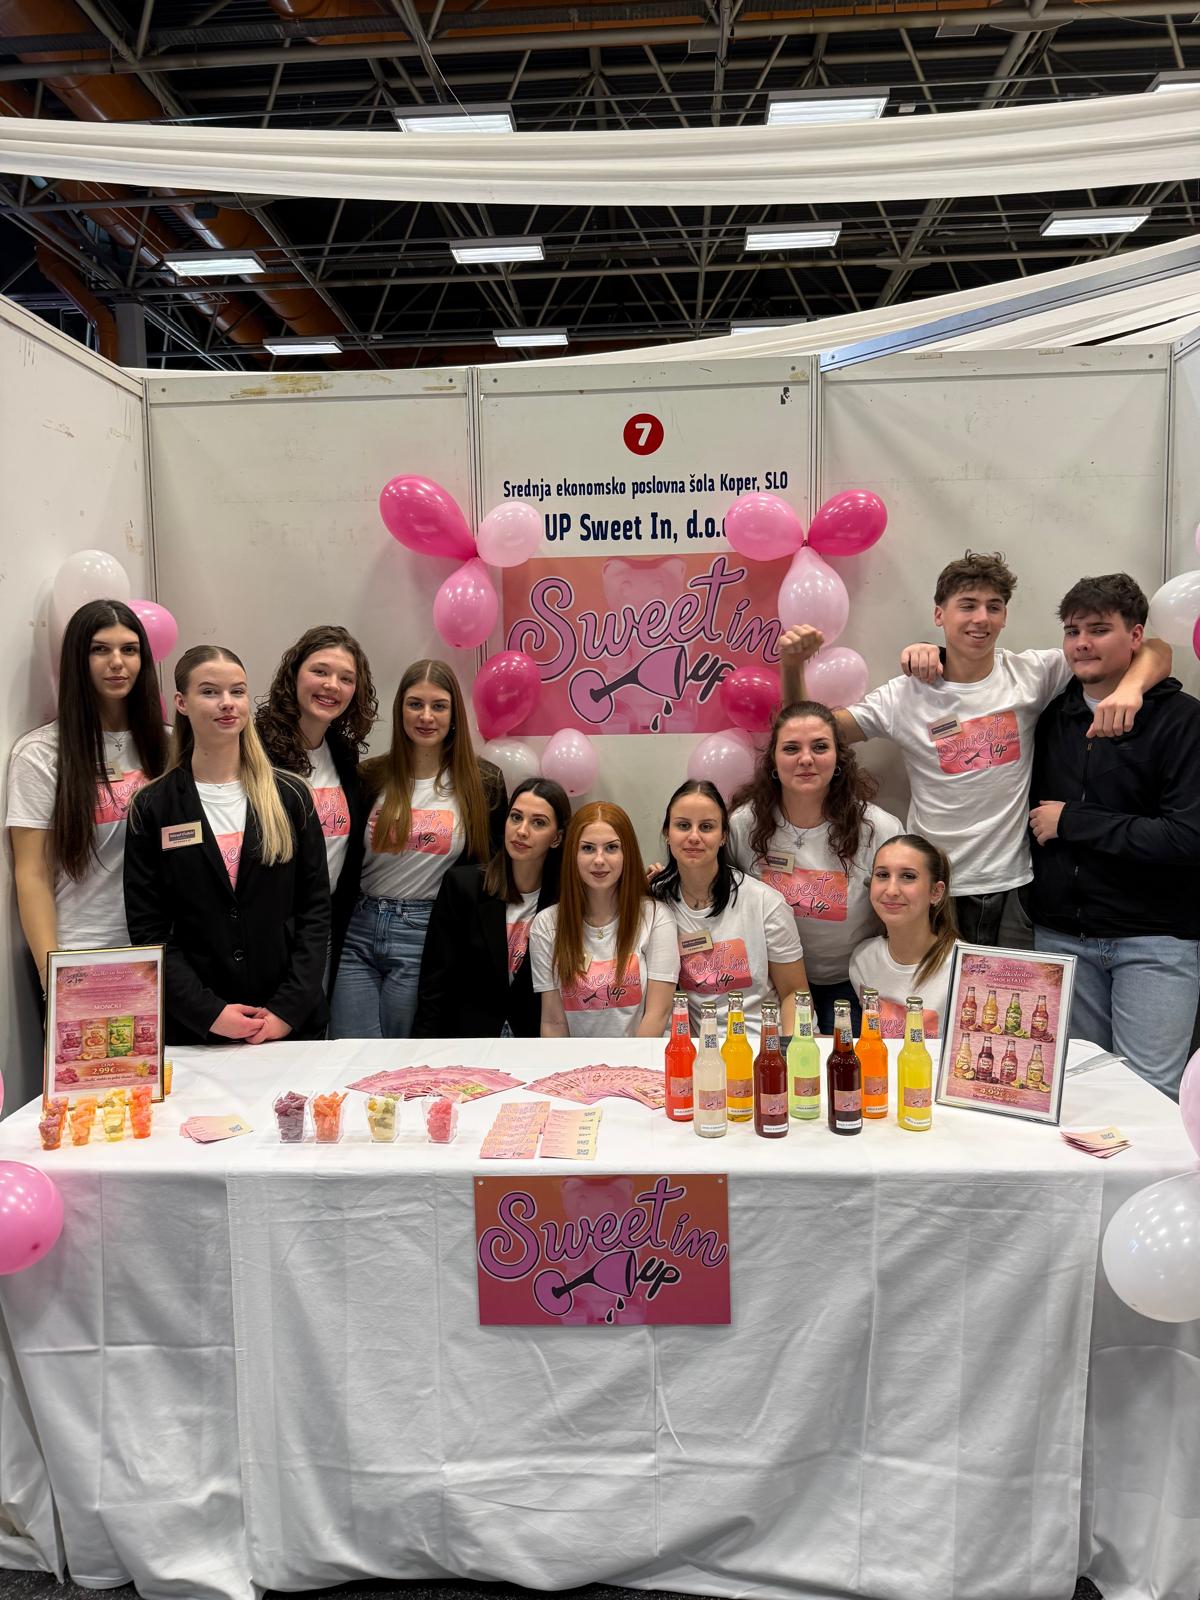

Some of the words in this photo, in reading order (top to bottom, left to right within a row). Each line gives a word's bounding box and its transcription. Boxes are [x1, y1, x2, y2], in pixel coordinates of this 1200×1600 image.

[634, 422, 652, 447] 7
[503, 479, 551, 501] Srednja
[556, 476, 626, 496] ekonomsko
[631, 475, 685, 499] poslovna
[689, 473, 715, 493] šola
[720, 473, 760, 495] Koper,
[765, 471, 788, 489] SLO
[545, 513, 571, 541] UP
[579, 513, 642, 541] Sweet
[650, 512, 678, 543] In,
[507, 556, 746, 682] Sweet
[726, 598, 783, 664] in
[478, 1177, 686, 1281] Sweet
[669, 1213, 728, 1268] in
[635, 1256, 681, 1301] up
